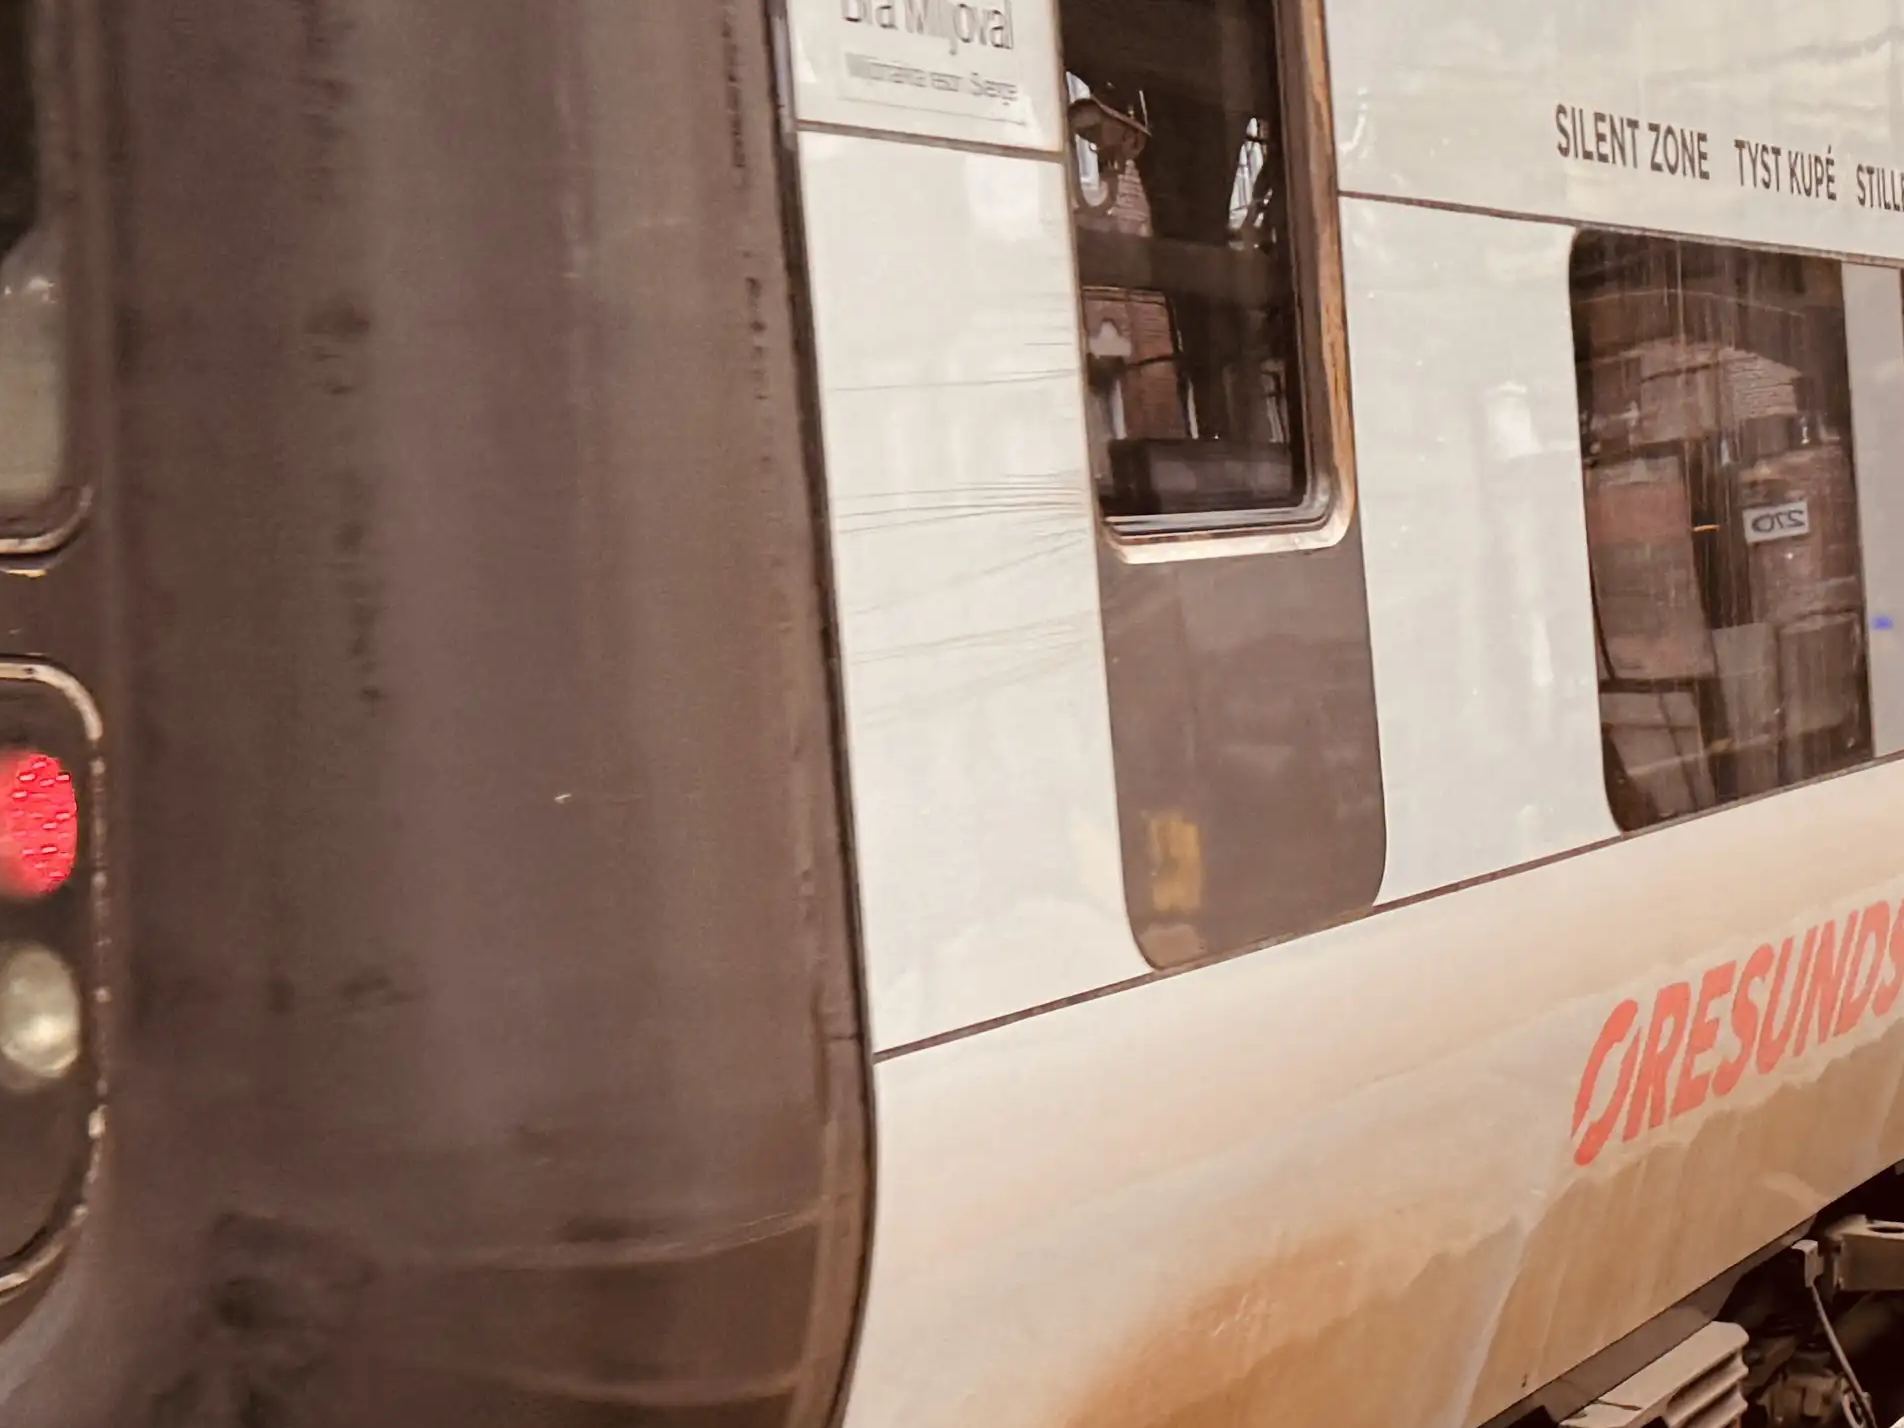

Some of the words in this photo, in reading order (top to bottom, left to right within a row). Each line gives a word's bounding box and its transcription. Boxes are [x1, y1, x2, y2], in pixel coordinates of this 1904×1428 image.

[1556, 103, 1639, 169] SILENT
[1648, 122, 1710, 180] ZONE
[1734, 139, 1781, 192] TYST
[1787, 144, 1837, 201] KUPÉ
